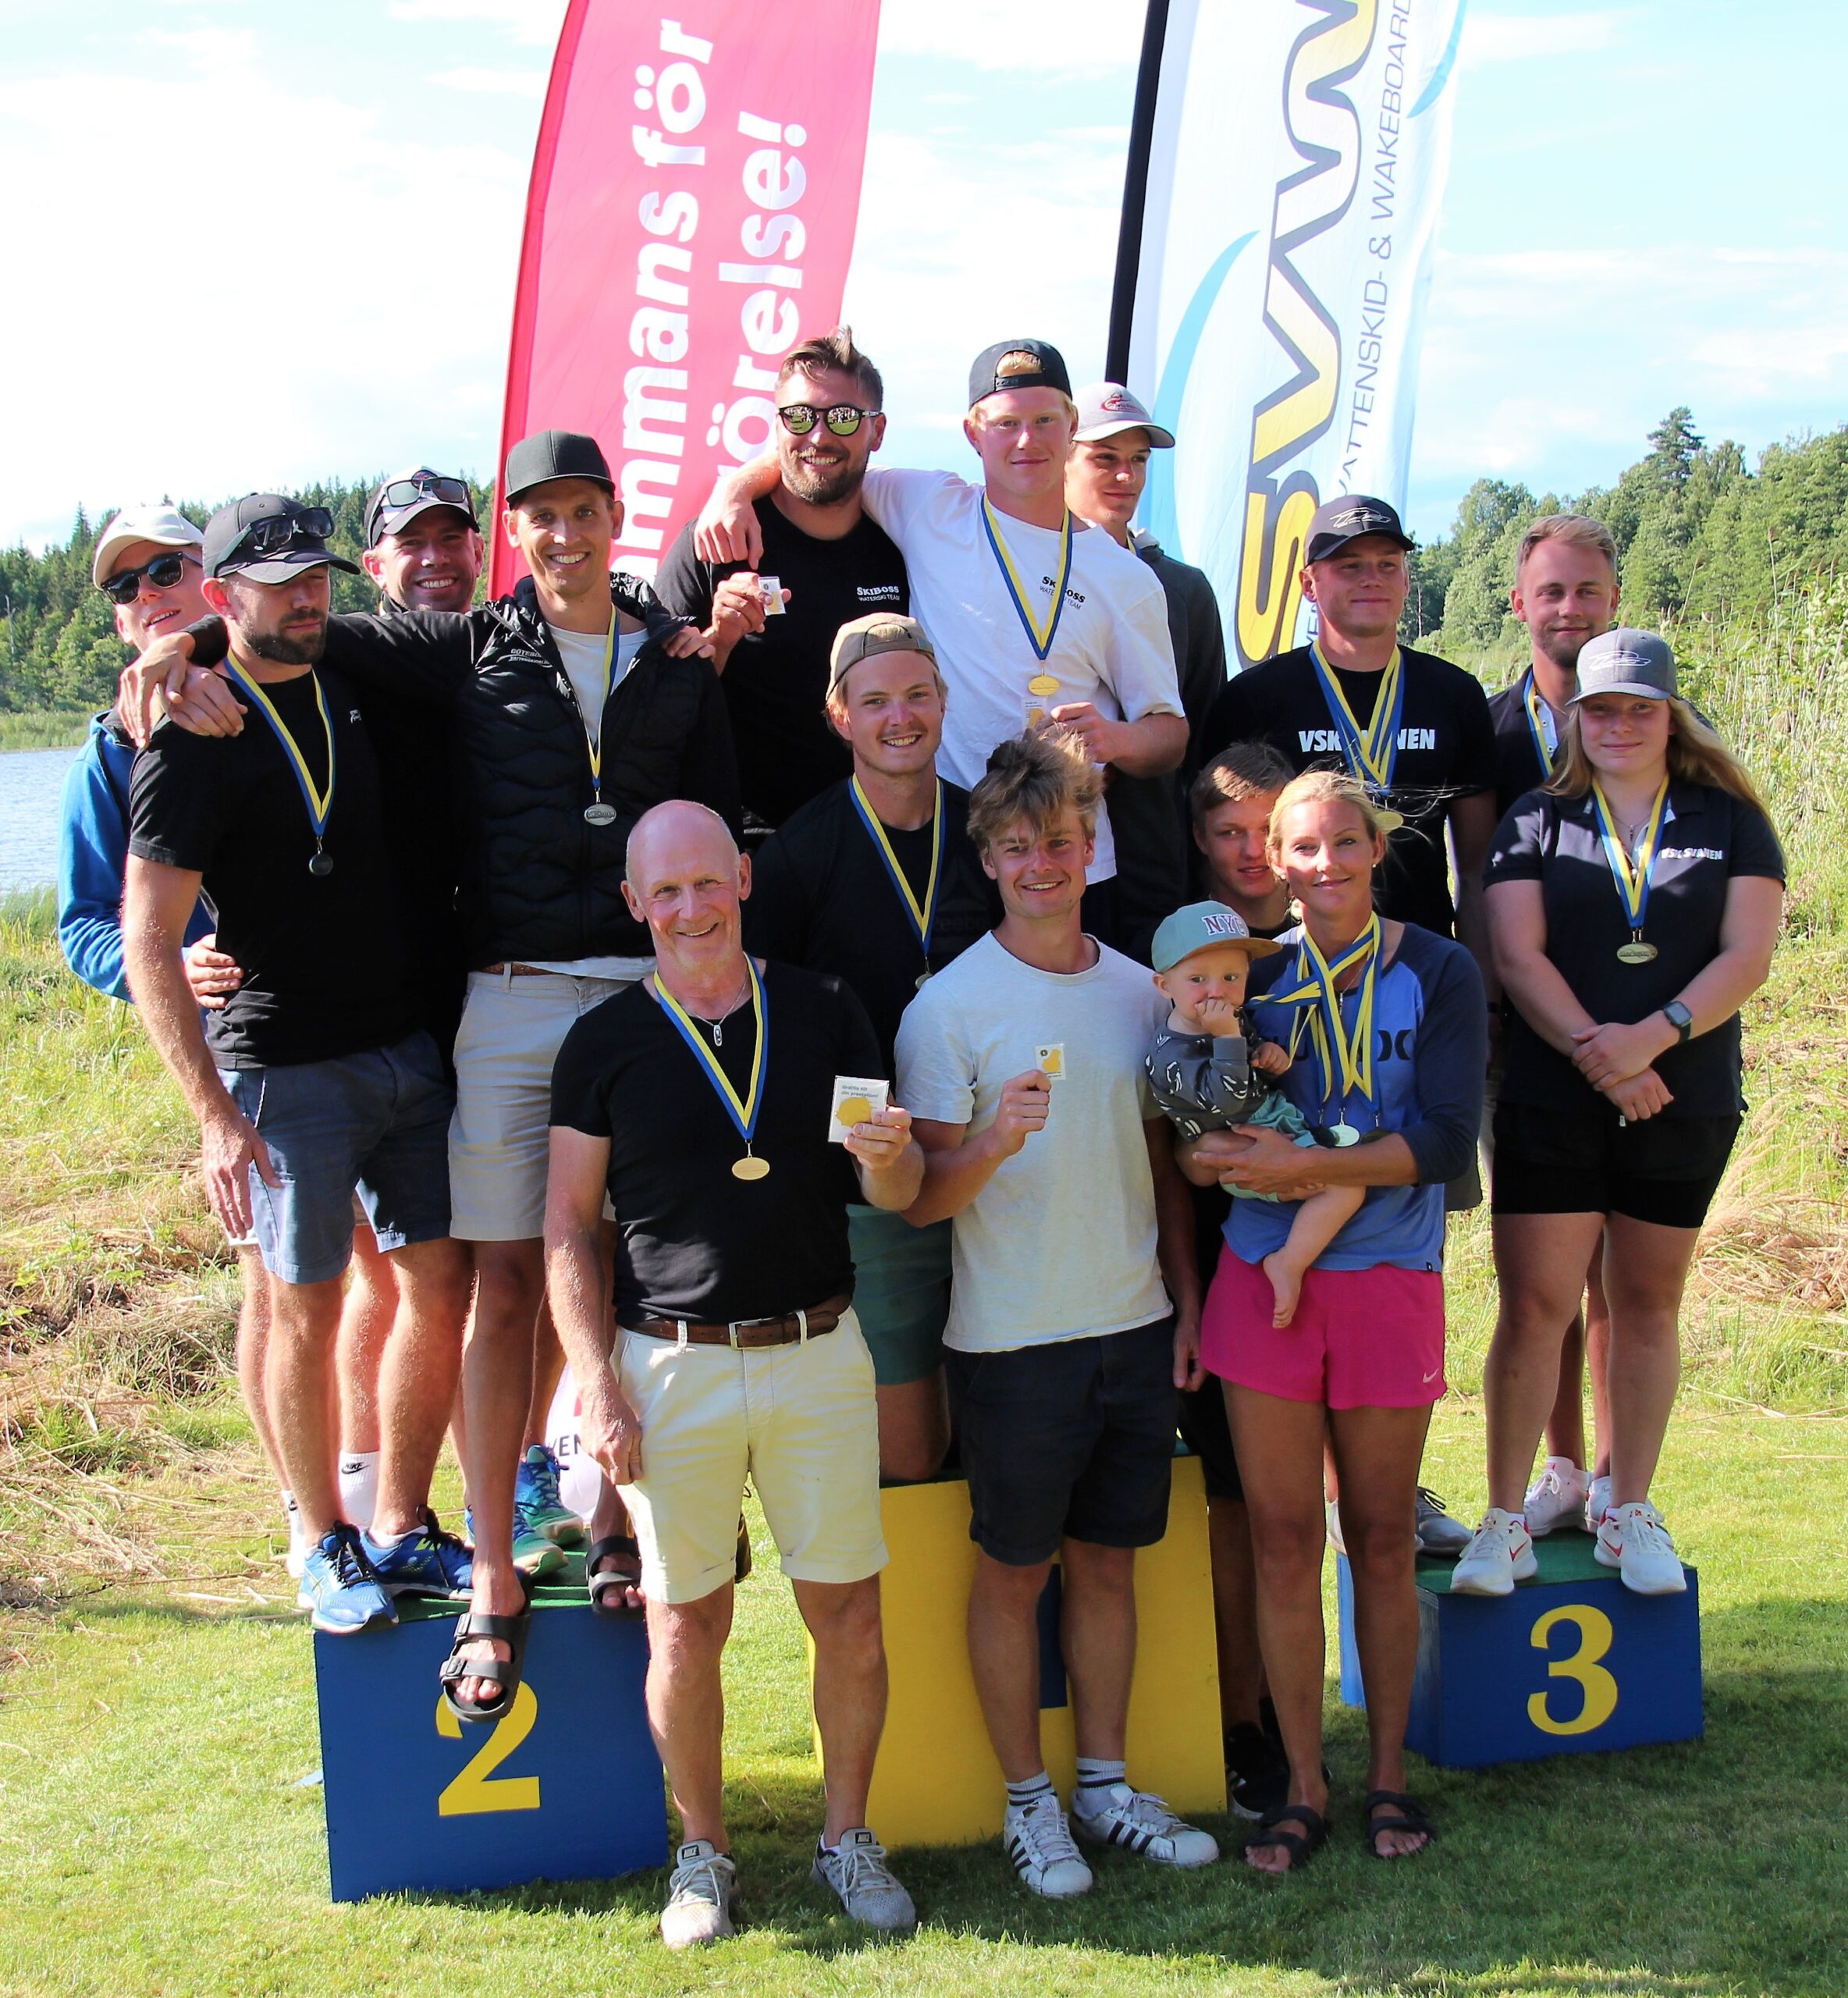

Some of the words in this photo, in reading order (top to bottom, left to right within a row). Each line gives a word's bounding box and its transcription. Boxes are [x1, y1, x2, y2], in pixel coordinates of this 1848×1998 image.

[632, 18, 713, 167] för
[1368, 234, 1391, 260] &
[706, 111, 807, 478] örelse!
[1041, 576, 1086, 603] SKOSS
[1067, 598, 1082, 610] TEAM
[1299, 729, 1343, 752] VSK
[1201, 913, 1246, 937] NYC
[1526, 1604, 1618, 1736] 3
[435, 1680, 541, 1816] 2
